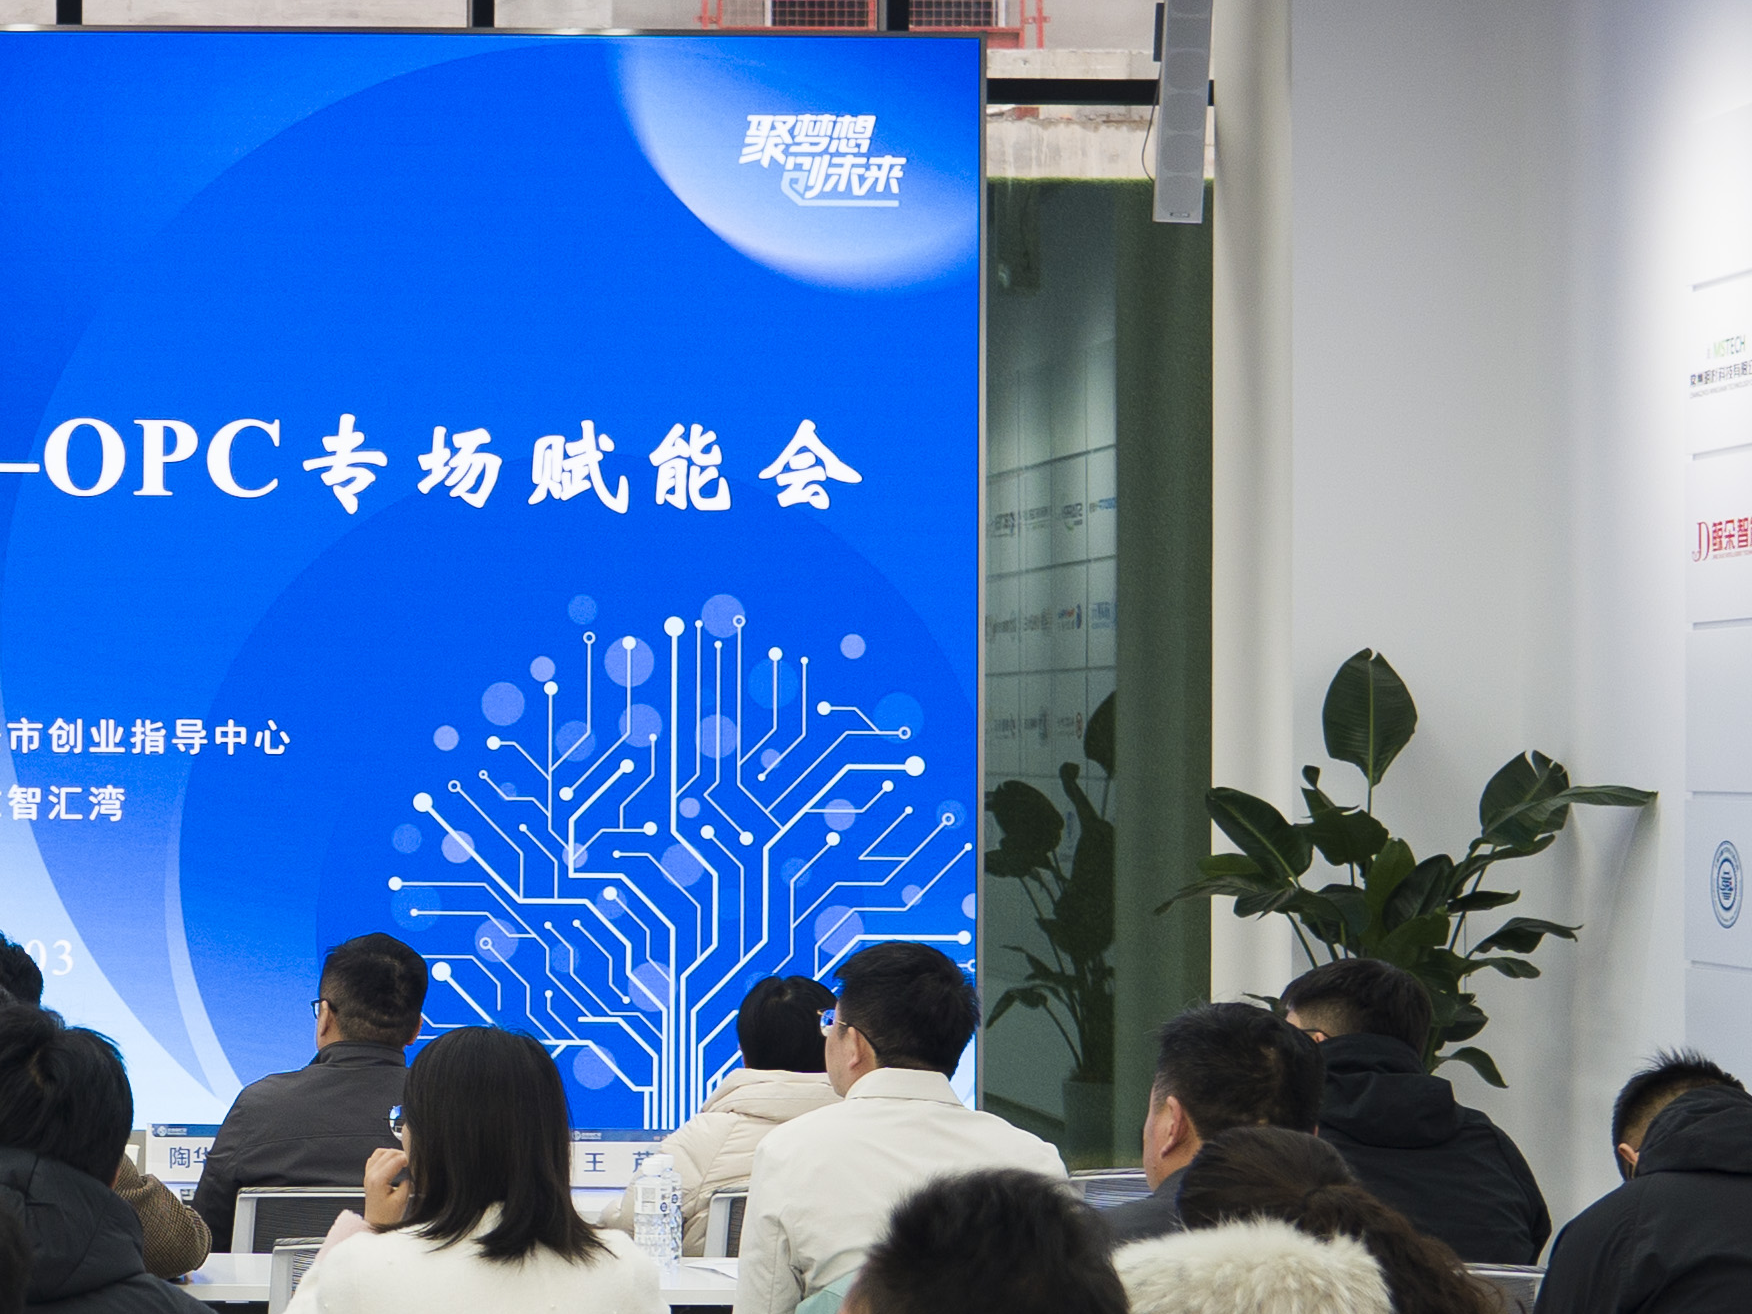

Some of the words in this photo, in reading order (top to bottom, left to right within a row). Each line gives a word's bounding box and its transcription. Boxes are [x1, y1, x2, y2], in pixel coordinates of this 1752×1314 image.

[738, 113, 877, 169] 聚梦想
[781, 154, 907, 206] 创未来
